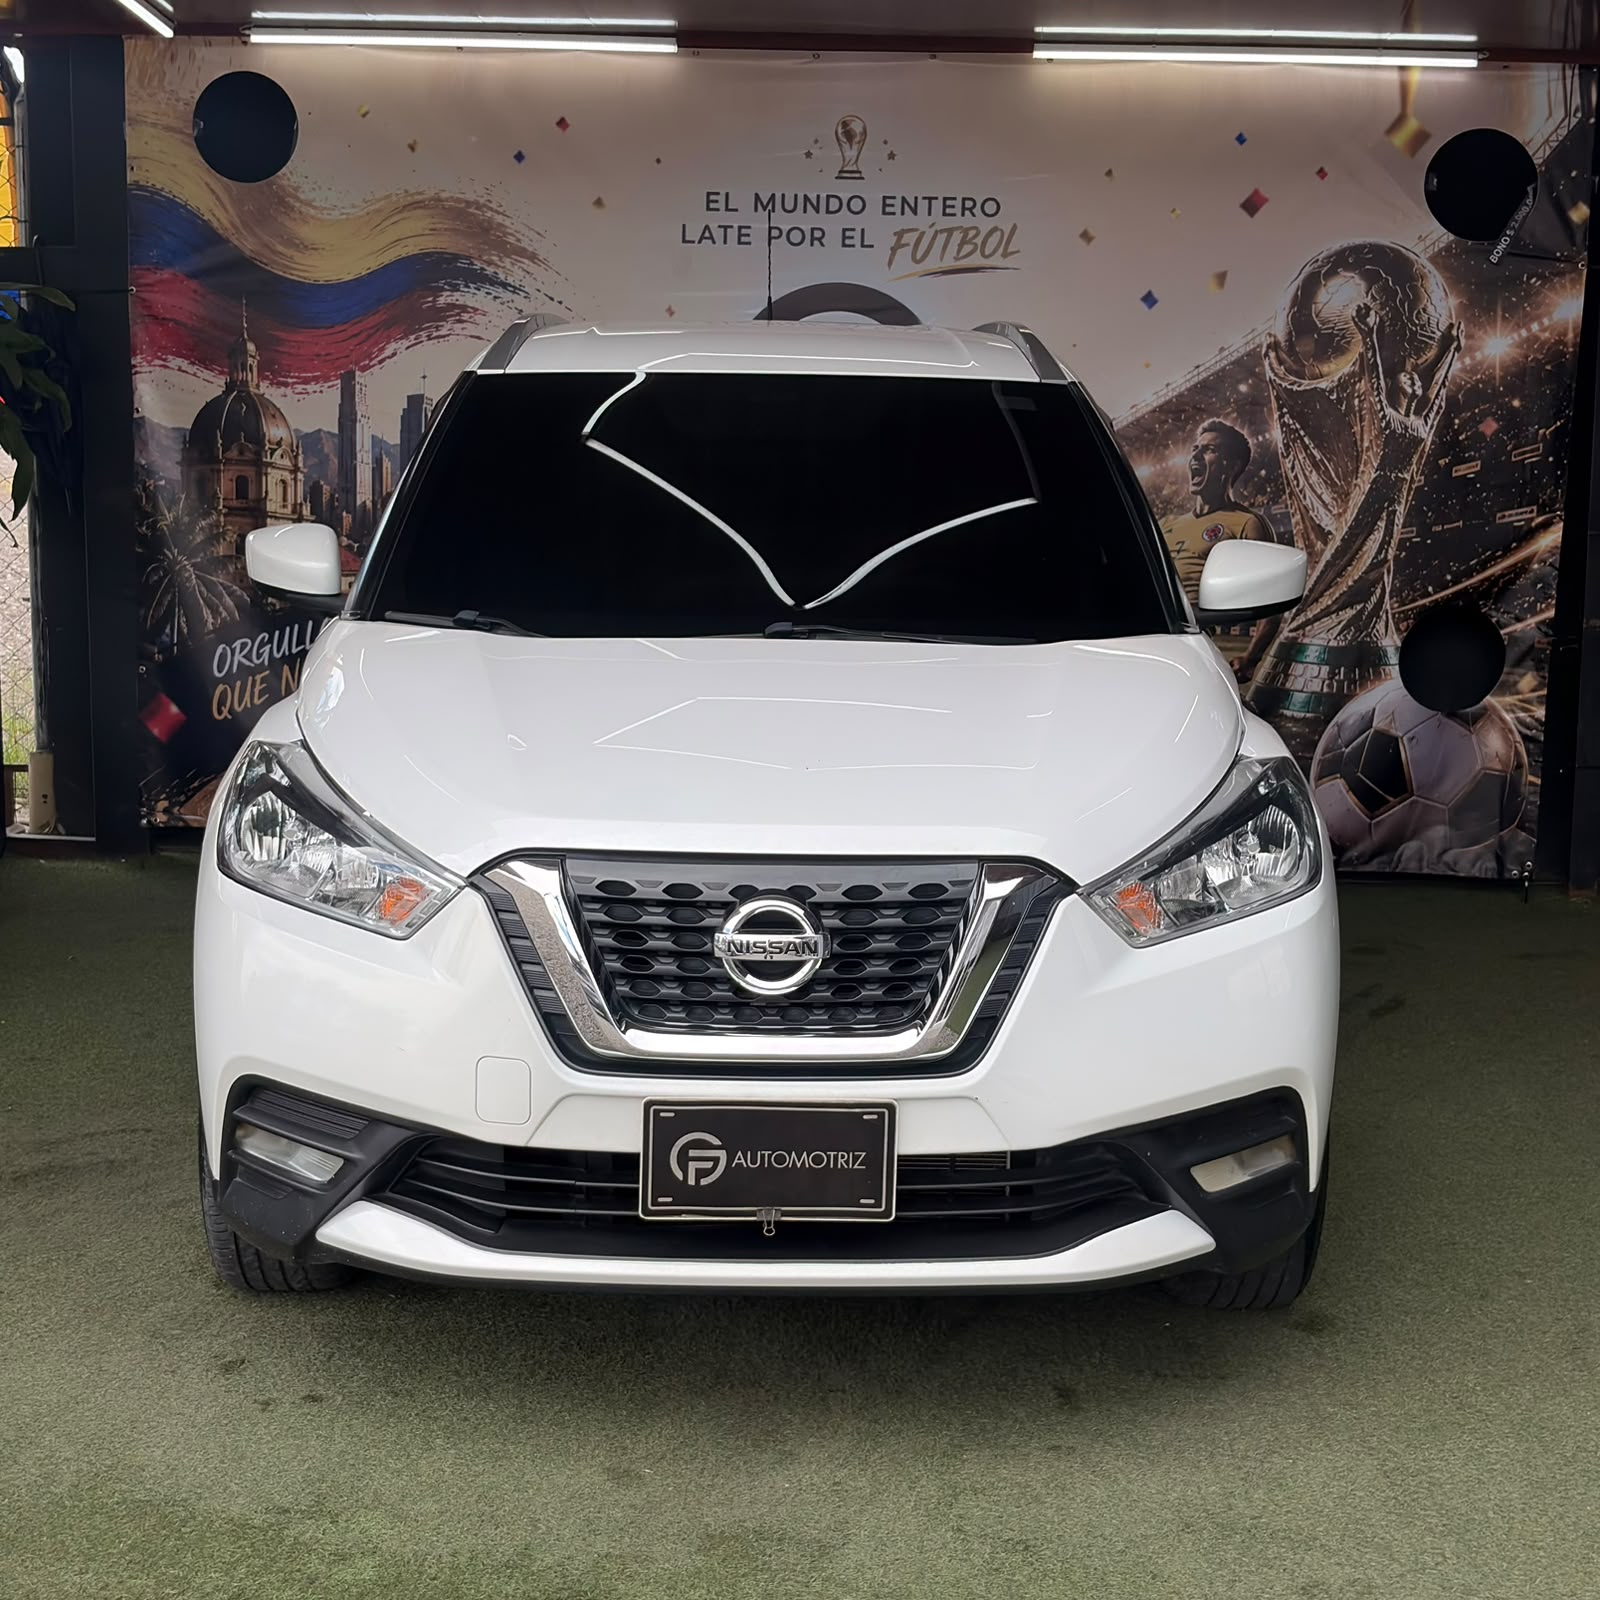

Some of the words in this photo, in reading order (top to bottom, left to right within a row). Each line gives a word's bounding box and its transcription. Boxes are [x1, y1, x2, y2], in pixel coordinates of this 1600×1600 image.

[704, 191, 739, 213] EL
[753, 192, 867, 215] MUNDO
[881, 195, 1001, 218] ENTERO
[681, 223, 753, 246] LATE
[768, 226, 827, 248] POR
[841, 227, 875, 249] EL
[887, 222, 1021, 271] FÚTBOL
[1489, 236, 1511, 264] BONO
[212, 670, 271, 721] QUE
[281, 658, 301, 697] N
[727, 940, 818, 955] NISSAN
[731, 1150, 866, 1170] AUTOMOTRIZ
